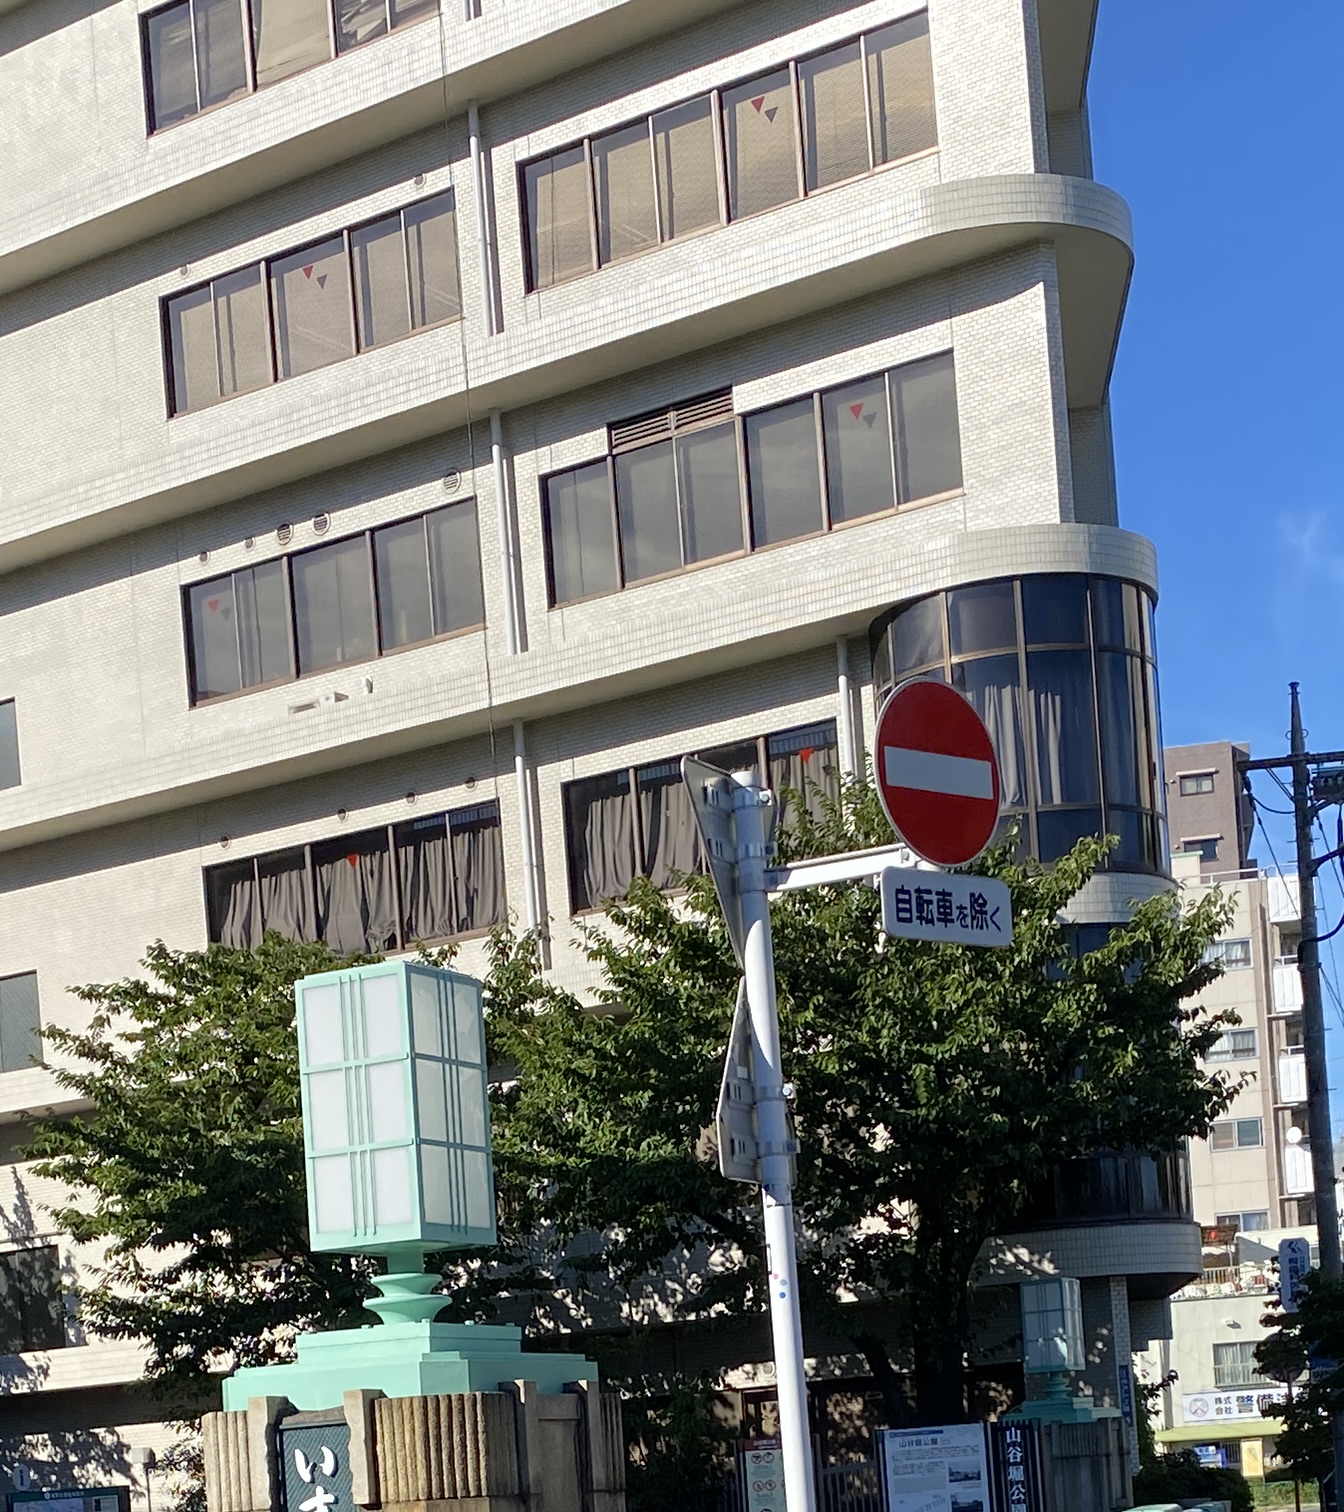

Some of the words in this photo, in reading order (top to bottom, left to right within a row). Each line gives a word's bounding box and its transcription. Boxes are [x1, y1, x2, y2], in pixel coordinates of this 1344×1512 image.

[894, 884, 1003, 934] 自転車を除く
[1215, 1405, 1233, 1415] 会社
